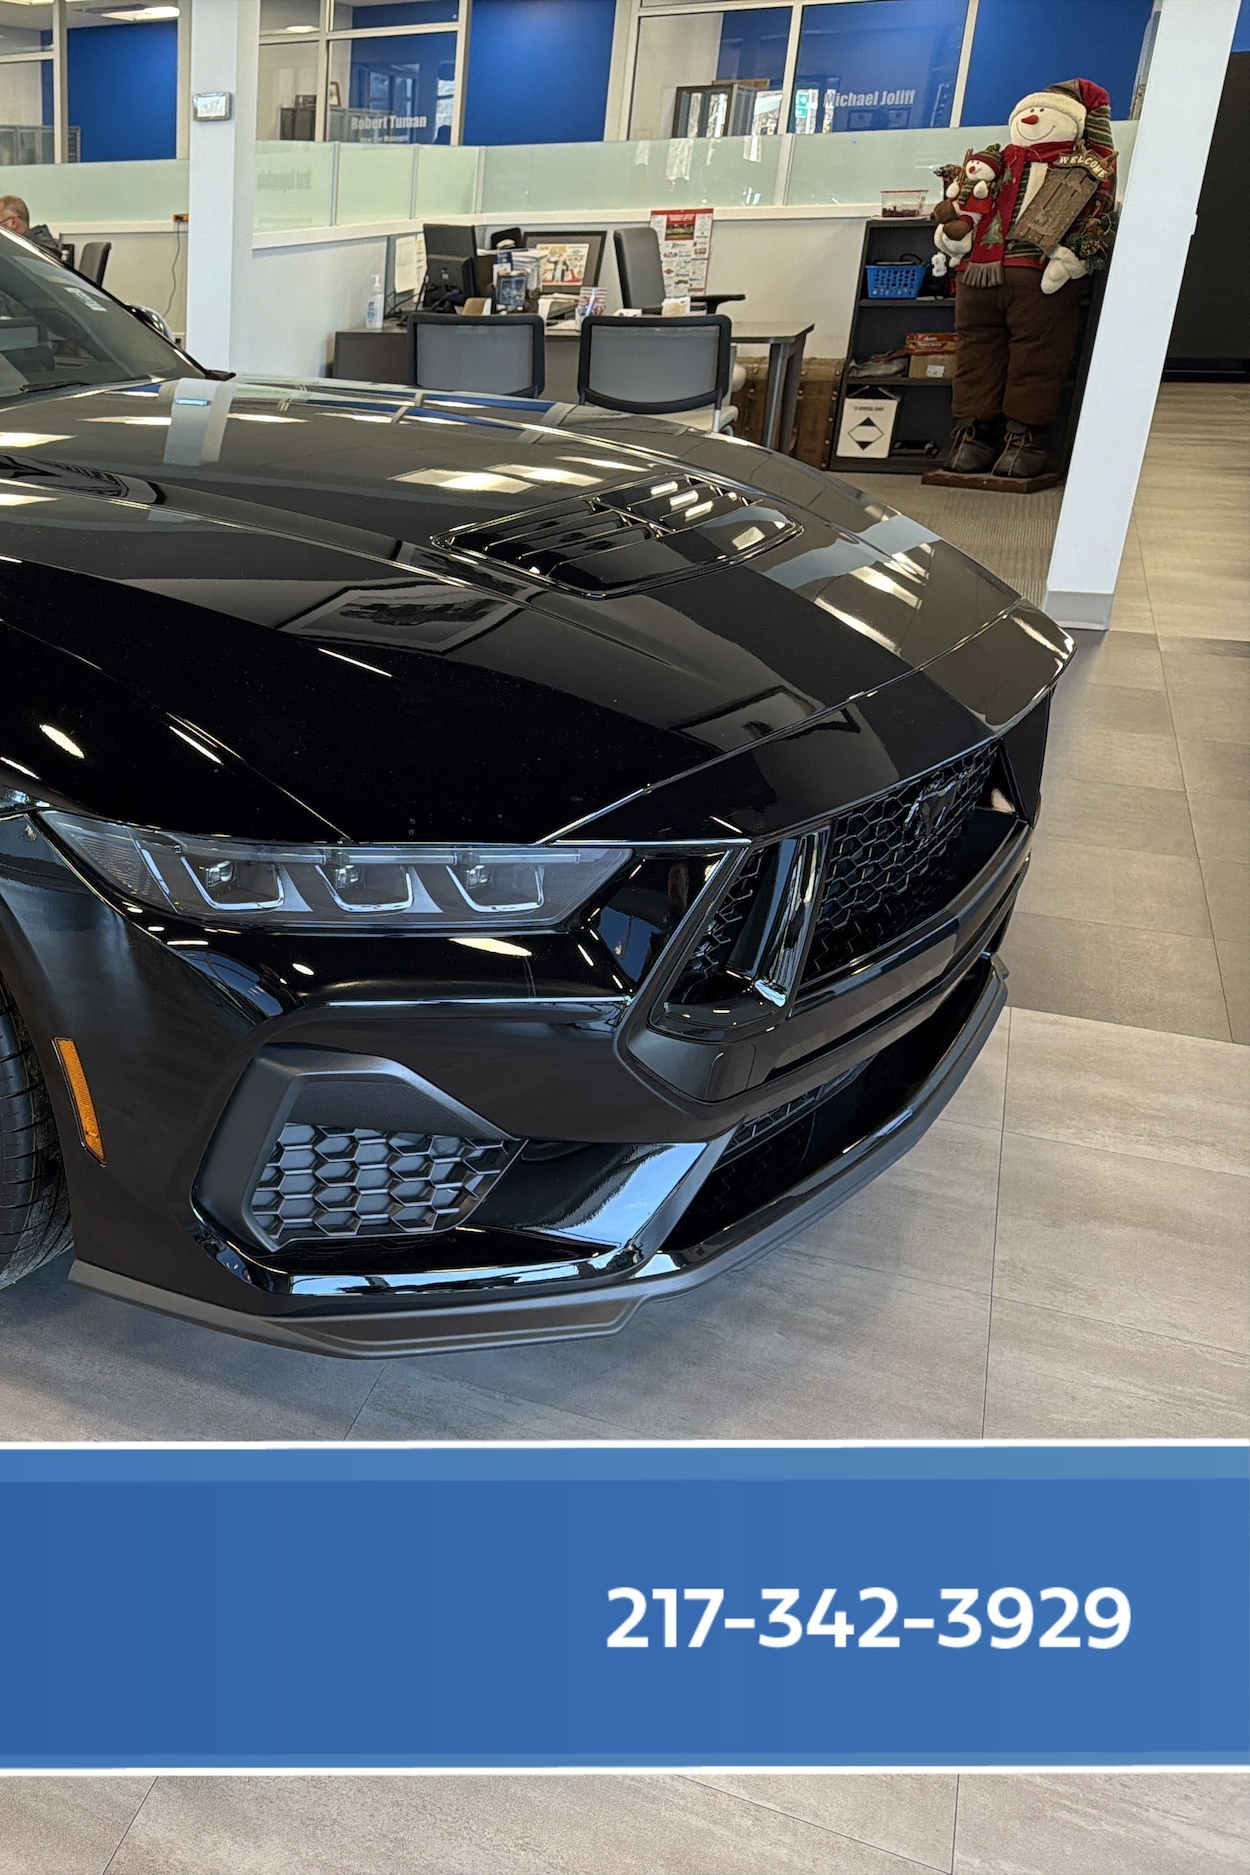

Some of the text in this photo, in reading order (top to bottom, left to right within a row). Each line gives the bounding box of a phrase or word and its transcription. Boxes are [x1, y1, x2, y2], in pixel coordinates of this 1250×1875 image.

[351, 115, 427, 129] Robert Tuman
[1059, 155, 1108, 178] WELCOME
